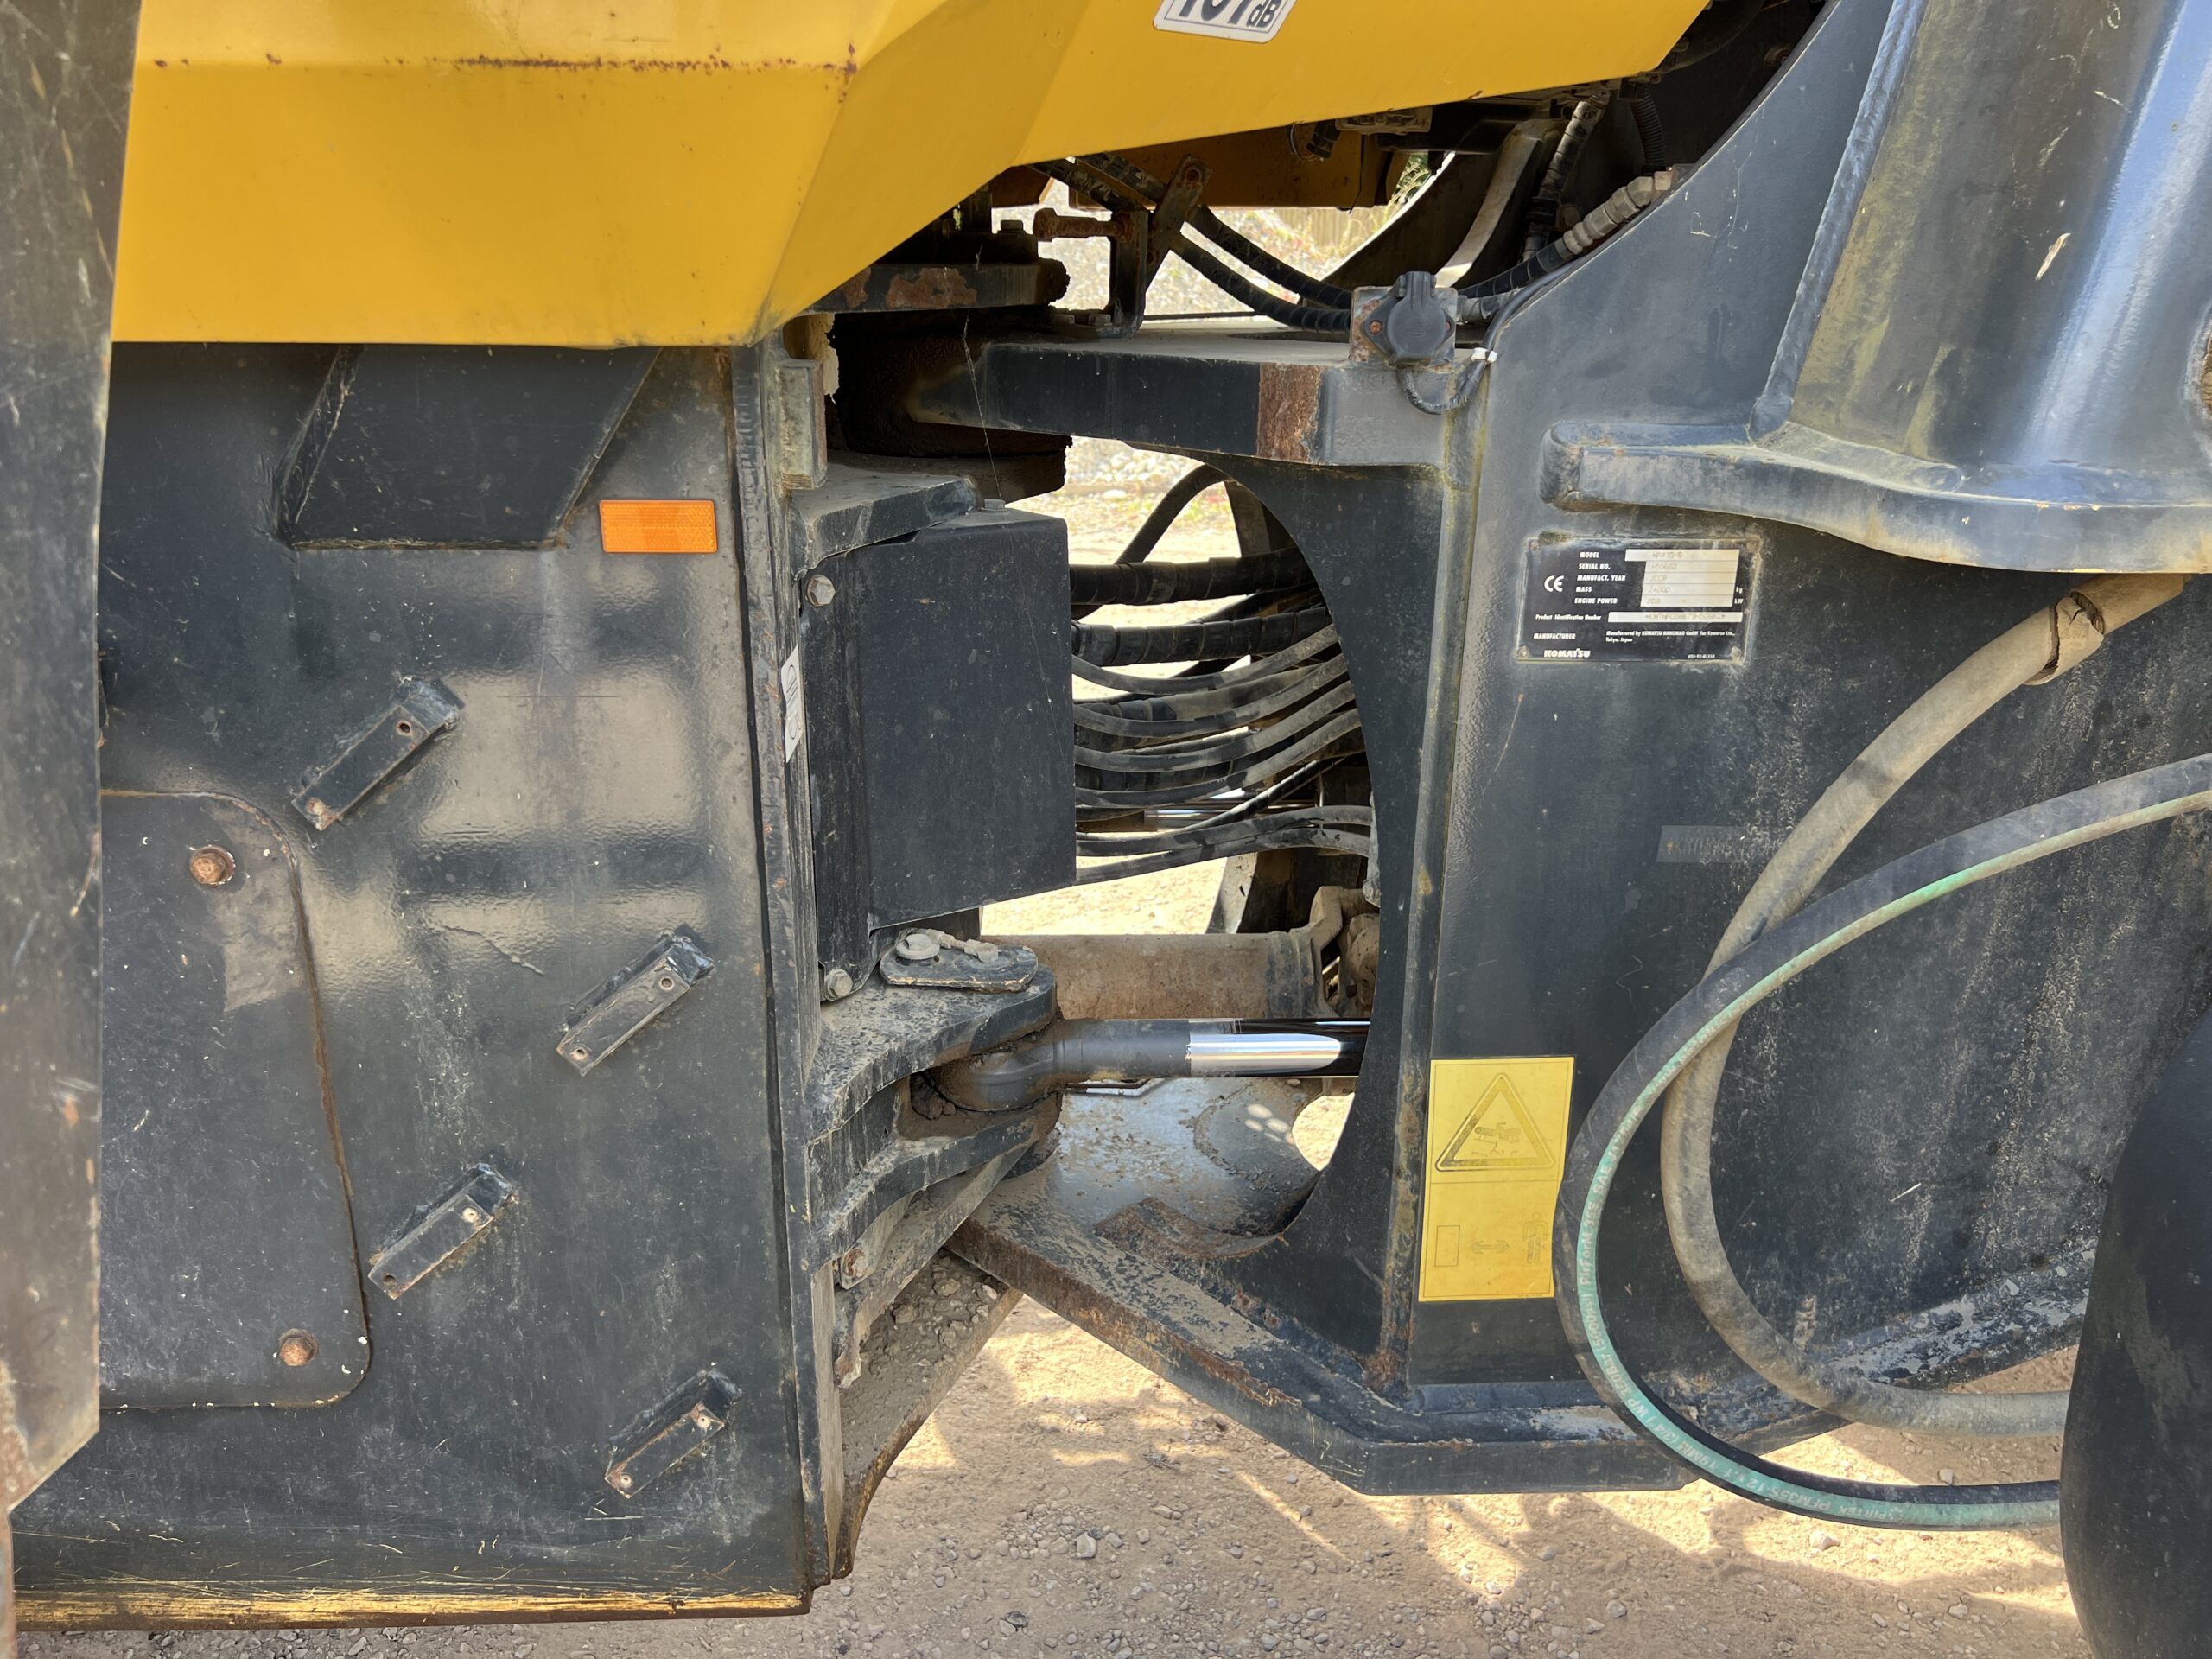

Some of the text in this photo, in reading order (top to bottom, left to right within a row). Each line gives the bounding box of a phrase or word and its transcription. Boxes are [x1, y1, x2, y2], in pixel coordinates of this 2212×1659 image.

[1544, 575, 1565, 593] CE
[1543, 648, 1591, 658] KOMATSU
[1592, 1164, 1613, 1195] SAE
[1627, 1398, 1649, 1418] WP
[1839, 1504, 1889, 1521] PIRTEK
